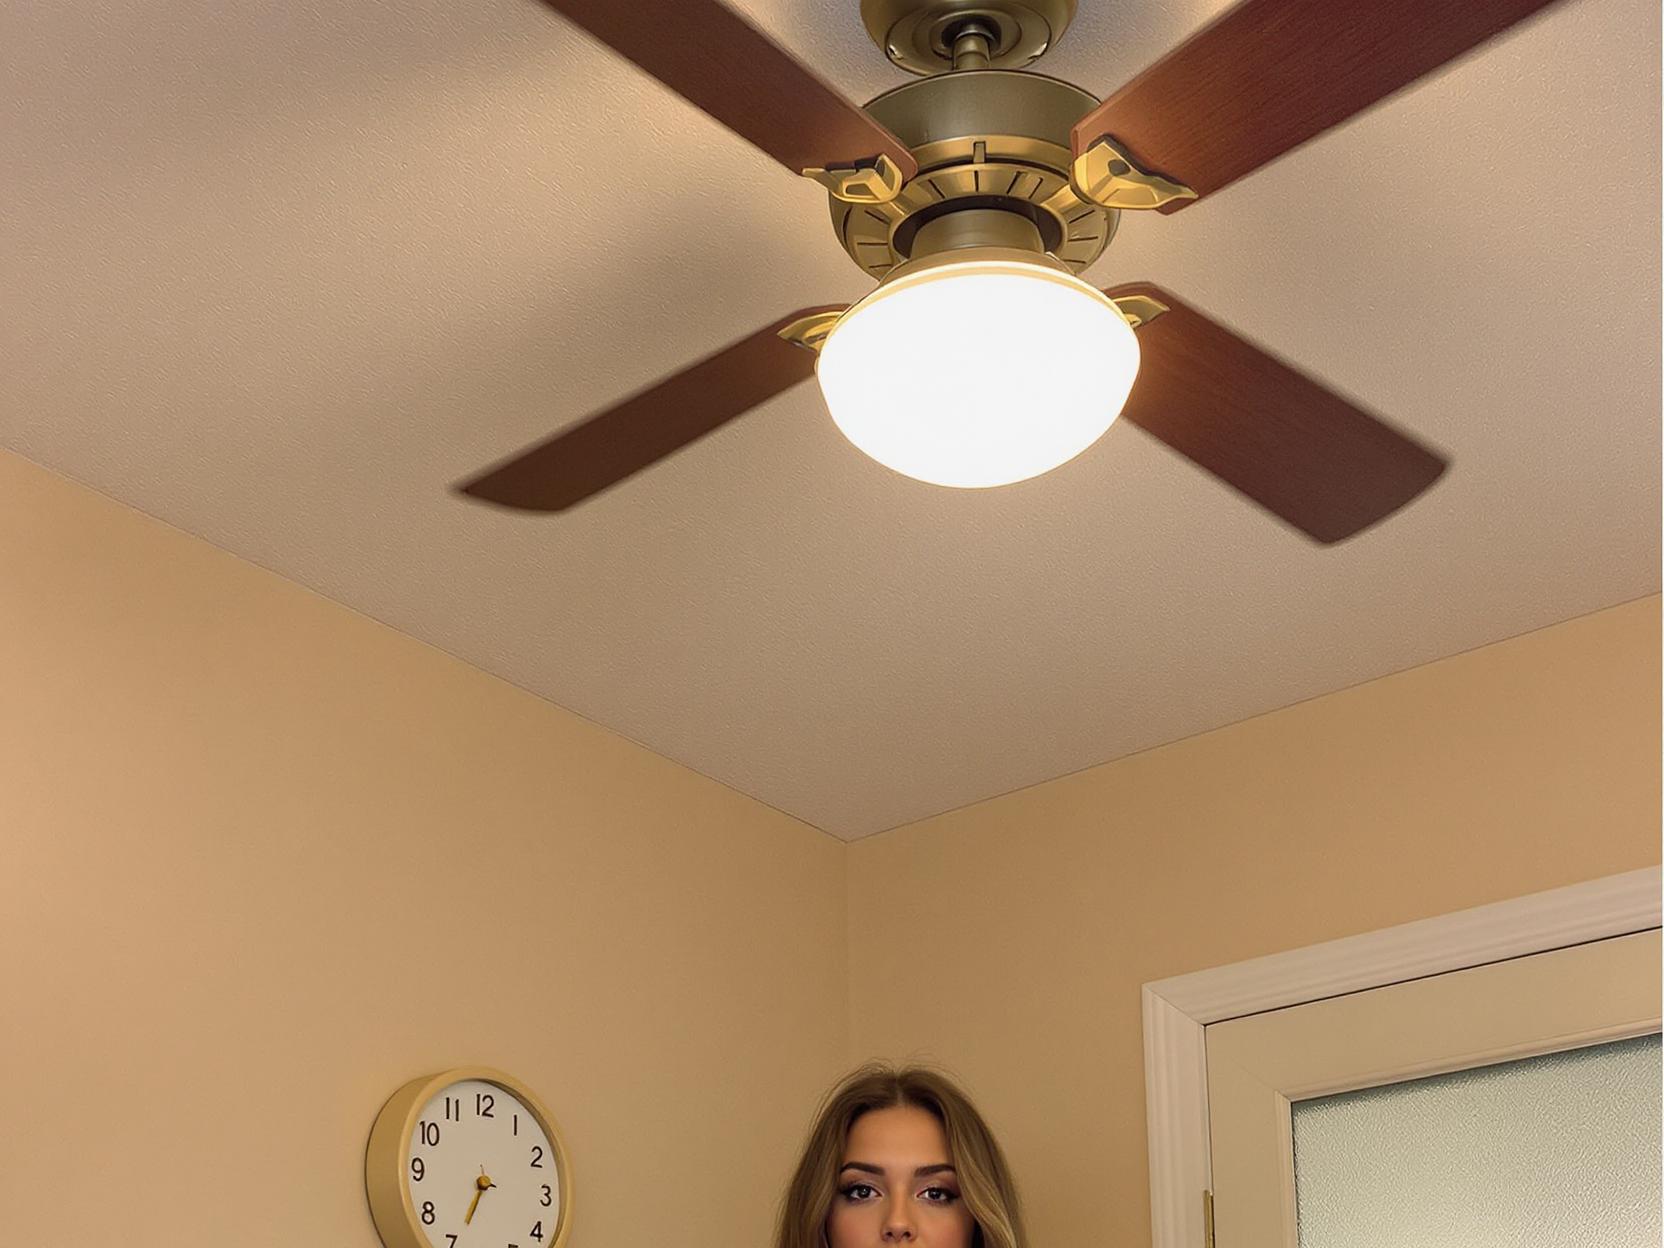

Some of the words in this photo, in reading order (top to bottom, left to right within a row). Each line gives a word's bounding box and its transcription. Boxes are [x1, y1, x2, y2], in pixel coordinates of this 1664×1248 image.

[446, 1097, 460, 1122] 11
[476, 1093, 495, 1118] 12
[419, 1120, 440, 1147] 10
[513, 1114, 518, 1136] 1
[411, 1157, 425, 1182] 9
[530, 1145, 543, 1169] 2
[539, 1183, 552, 1207] 3
[421, 1200, 436, 1226] 8
[529, 1220, 544, 1243] 4
